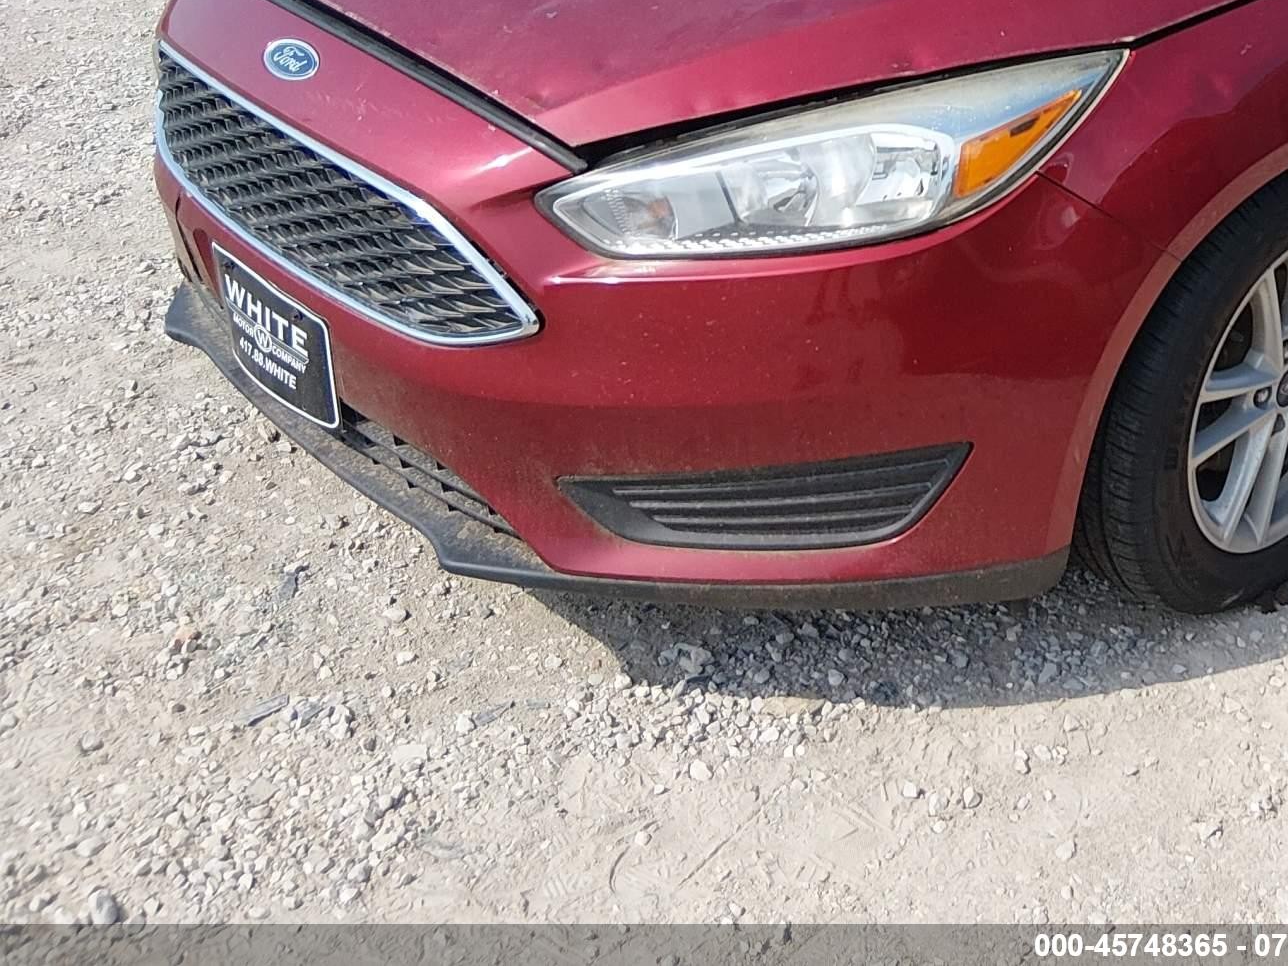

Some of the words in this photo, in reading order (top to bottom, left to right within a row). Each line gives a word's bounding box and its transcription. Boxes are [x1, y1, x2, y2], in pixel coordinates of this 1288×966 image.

[274, 46, 307, 73] Ford
[225, 273, 309, 359] WHITE
[233, 312, 254, 338] MOTOR
[271, 345, 307, 374] COMPANY
[239, 336, 298, 390] 417.88.WHITE
